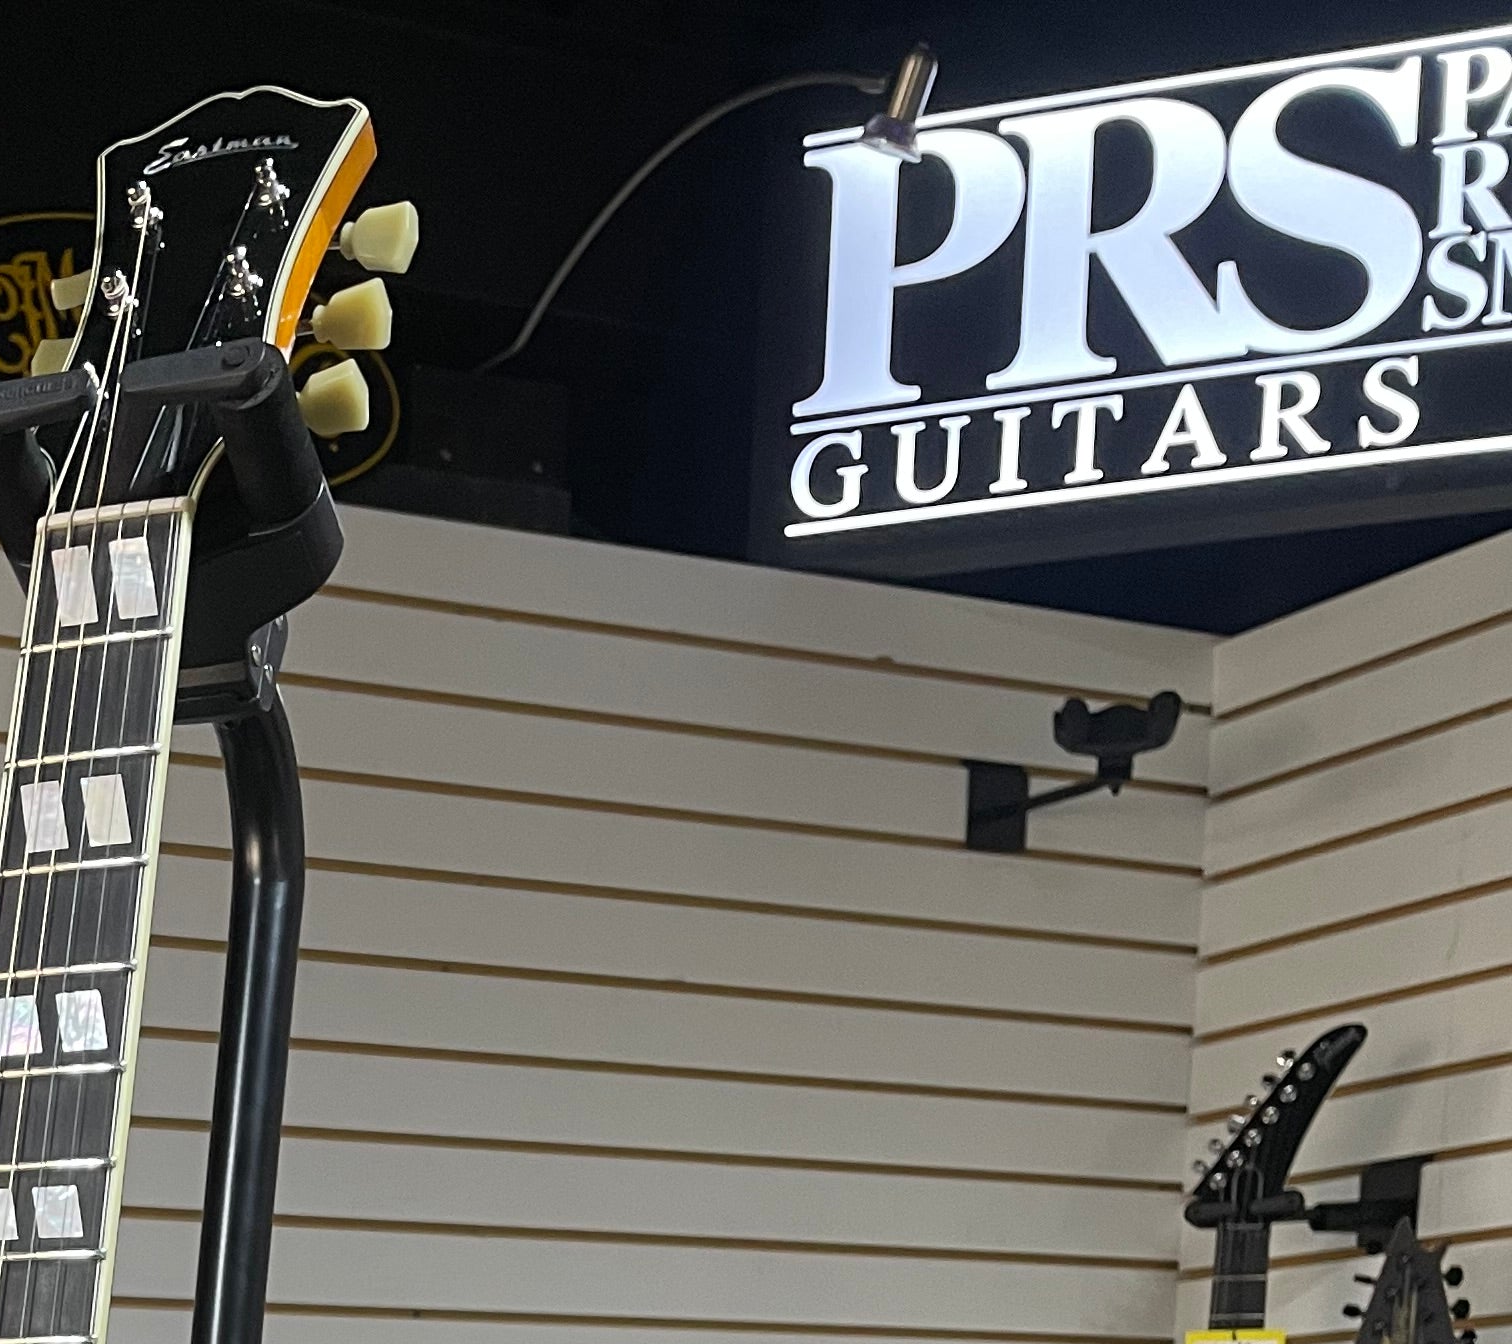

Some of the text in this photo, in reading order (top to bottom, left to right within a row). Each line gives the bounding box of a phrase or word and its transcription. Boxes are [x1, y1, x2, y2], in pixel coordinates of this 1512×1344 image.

[143, 136, 300, 175] Eastman
[792, 57, 1424, 418] PRS
[790, 356, 1422, 518] GUITARS
